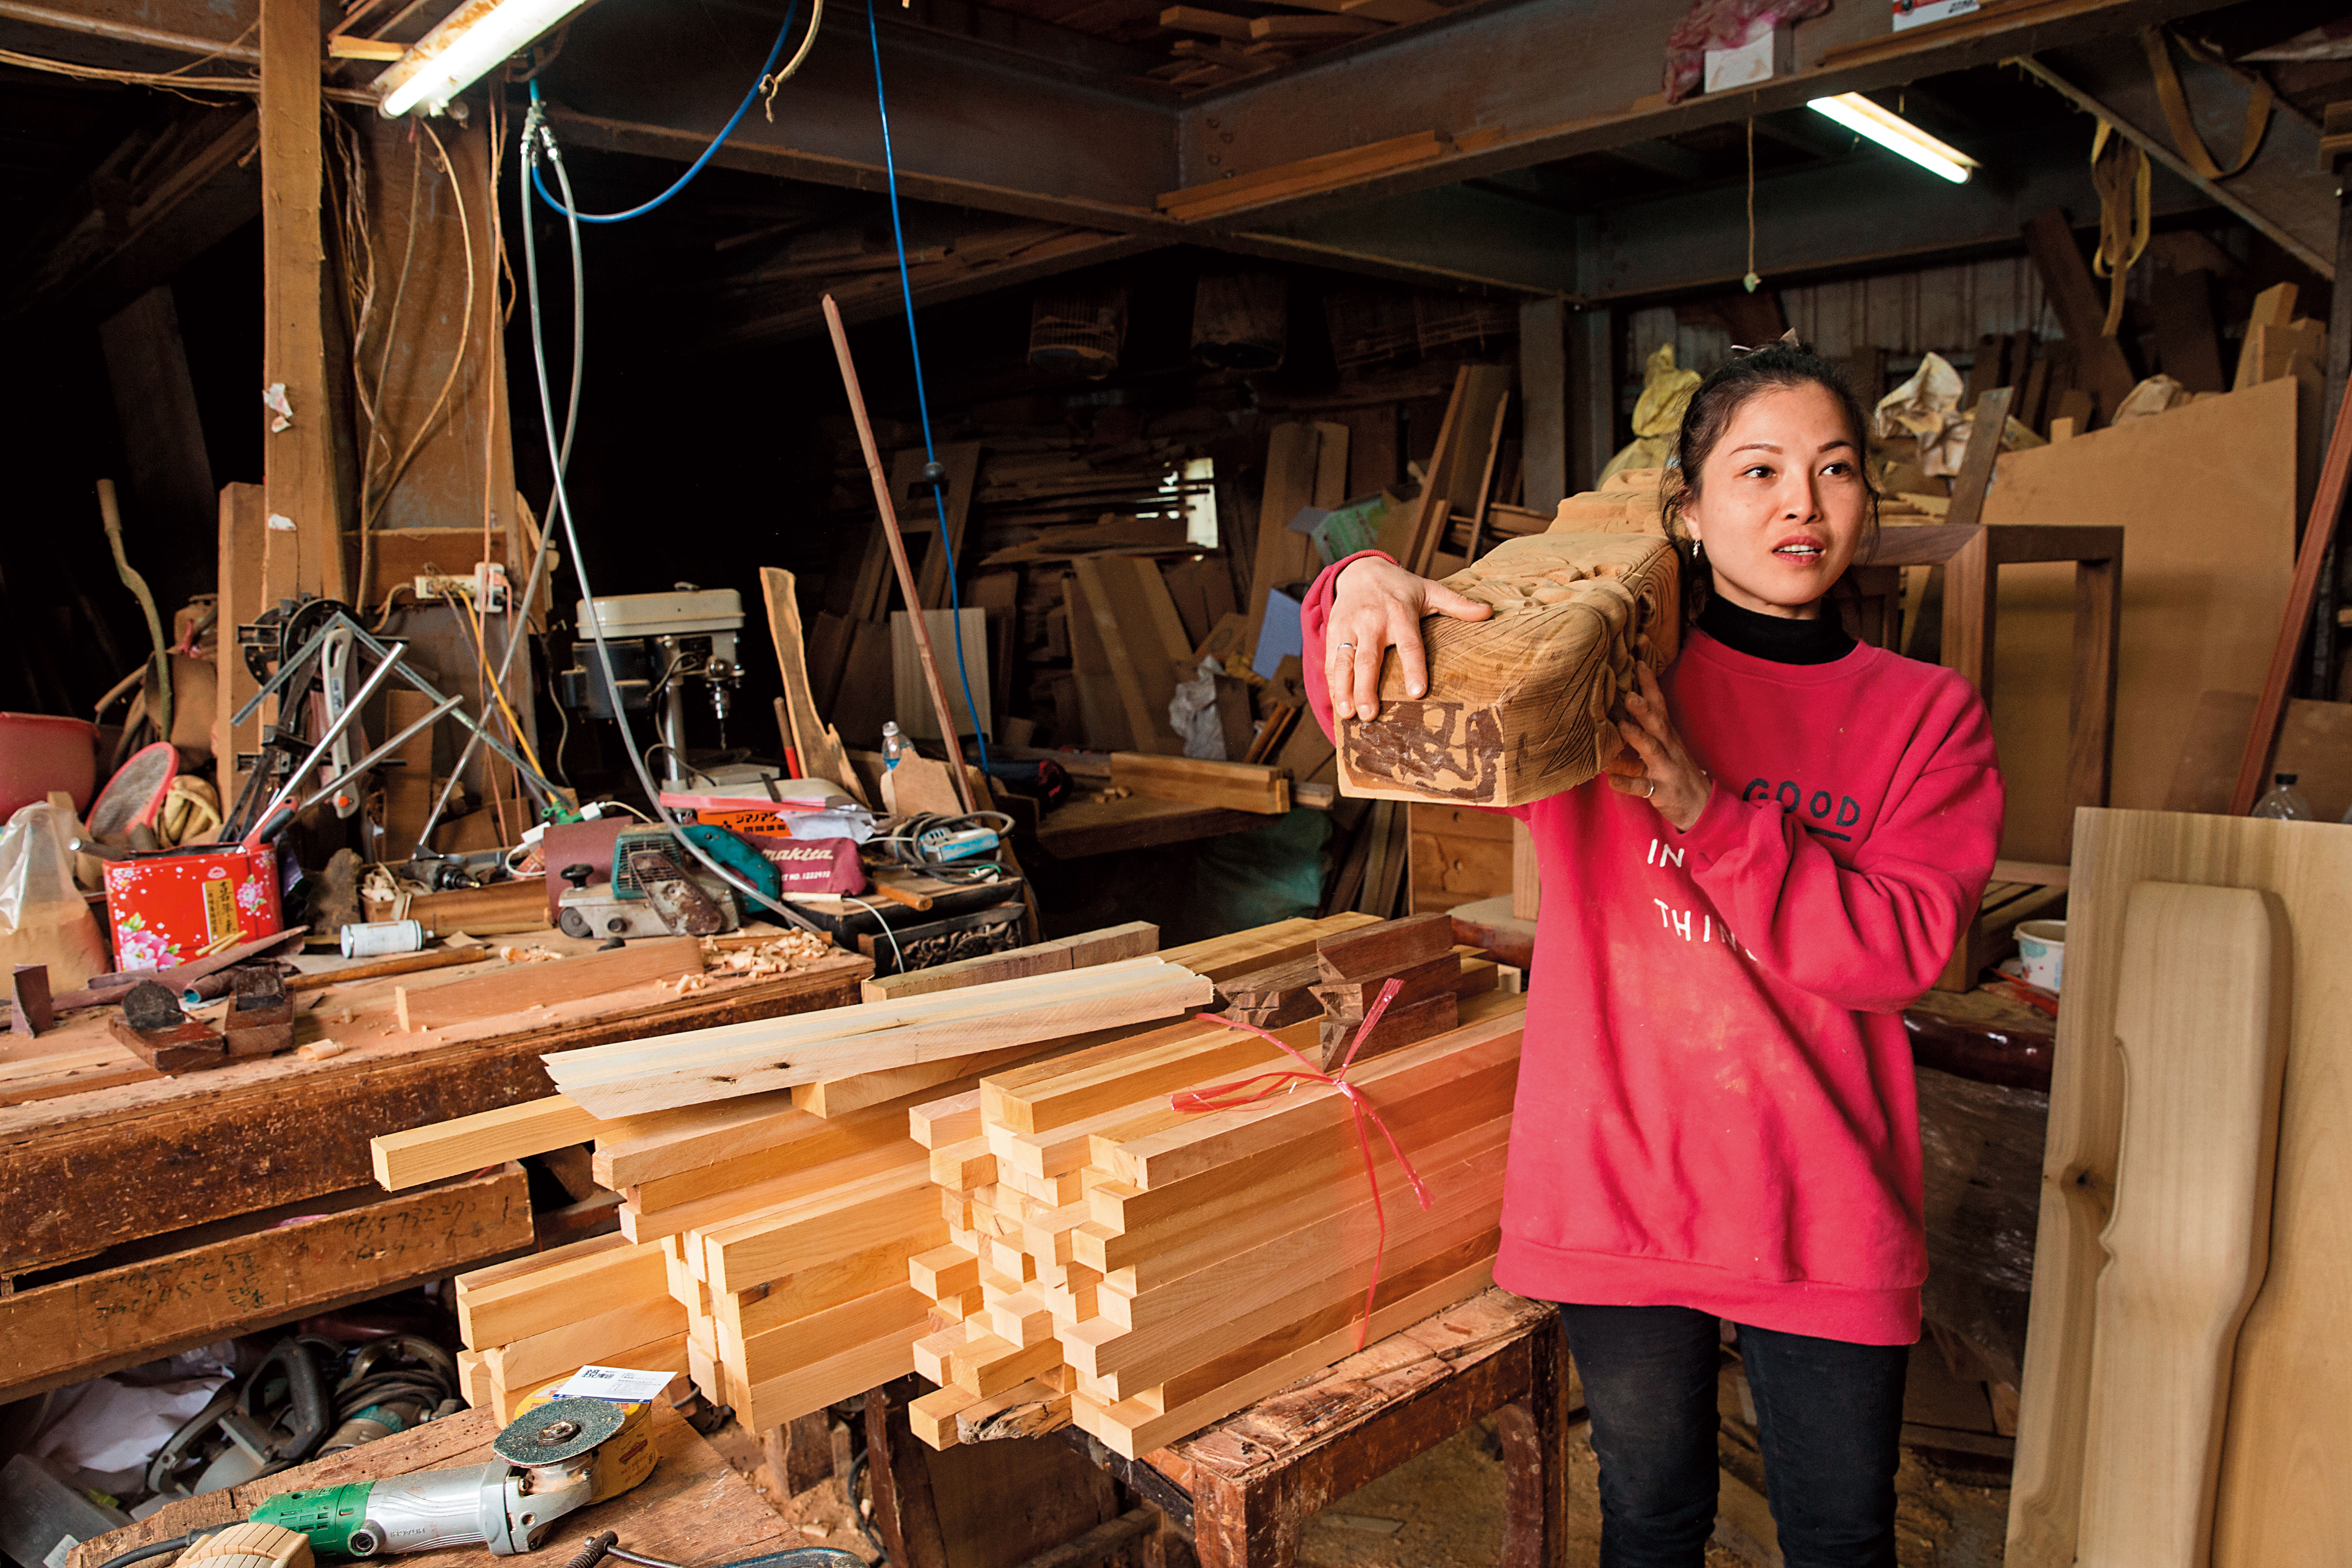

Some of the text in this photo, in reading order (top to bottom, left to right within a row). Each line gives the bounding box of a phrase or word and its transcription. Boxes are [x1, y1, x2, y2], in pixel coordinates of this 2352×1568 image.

[1742, 778, 1861, 827] GOOD
[1647, 839, 1685, 867] IN
[1654, 898, 1757, 961] THIN
[390, 1527, 425, 1537] HITACHI
